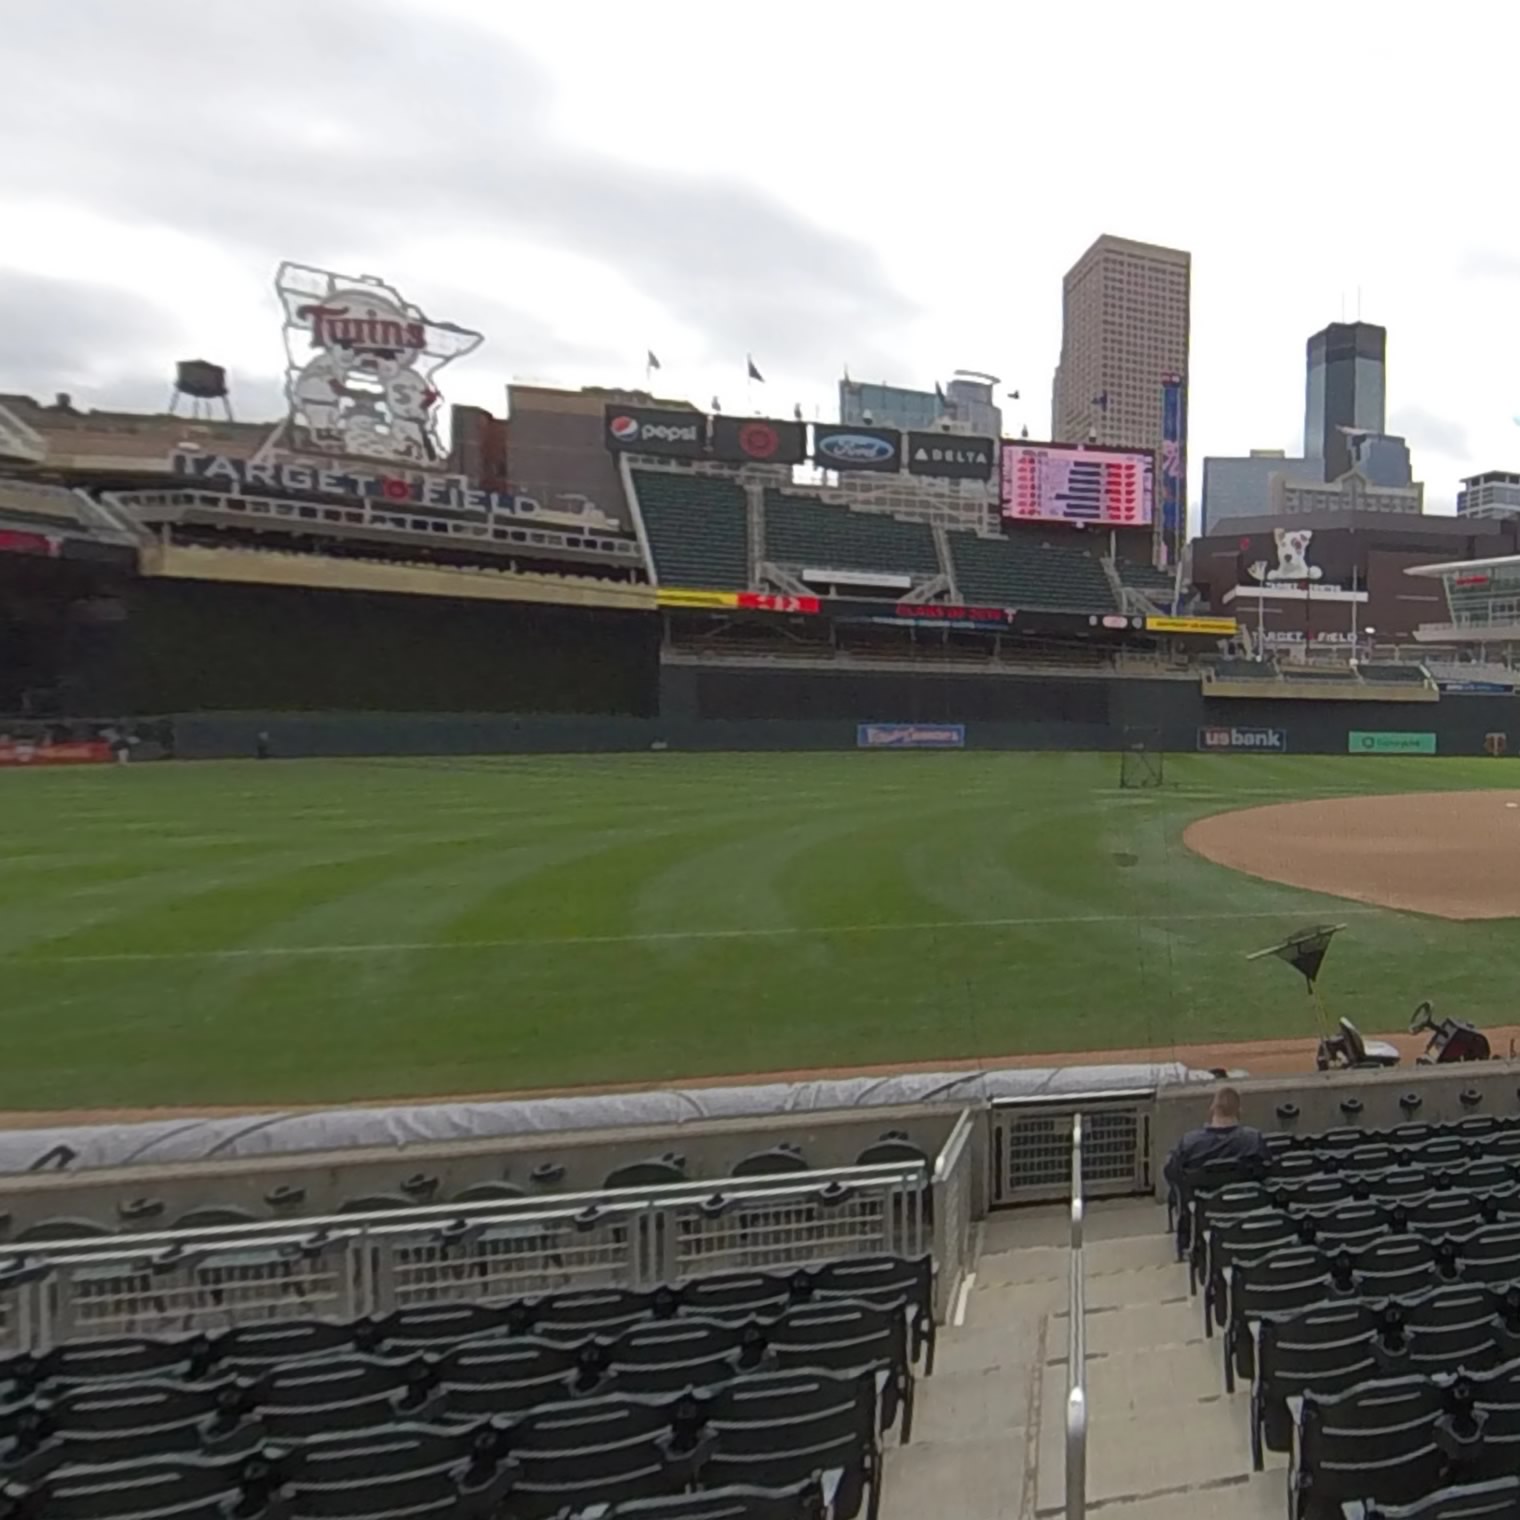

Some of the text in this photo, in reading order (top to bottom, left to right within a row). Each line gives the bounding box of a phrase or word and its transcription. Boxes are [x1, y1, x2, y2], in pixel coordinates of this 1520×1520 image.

[296, 304, 428, 351] Twins
[641, 424, 697, 442] pepsi
[833, 438, 881, 458] Ford
[932, 449, 988, 465] DELTA
[182, 454, 542, 516] TARGET FIELD
